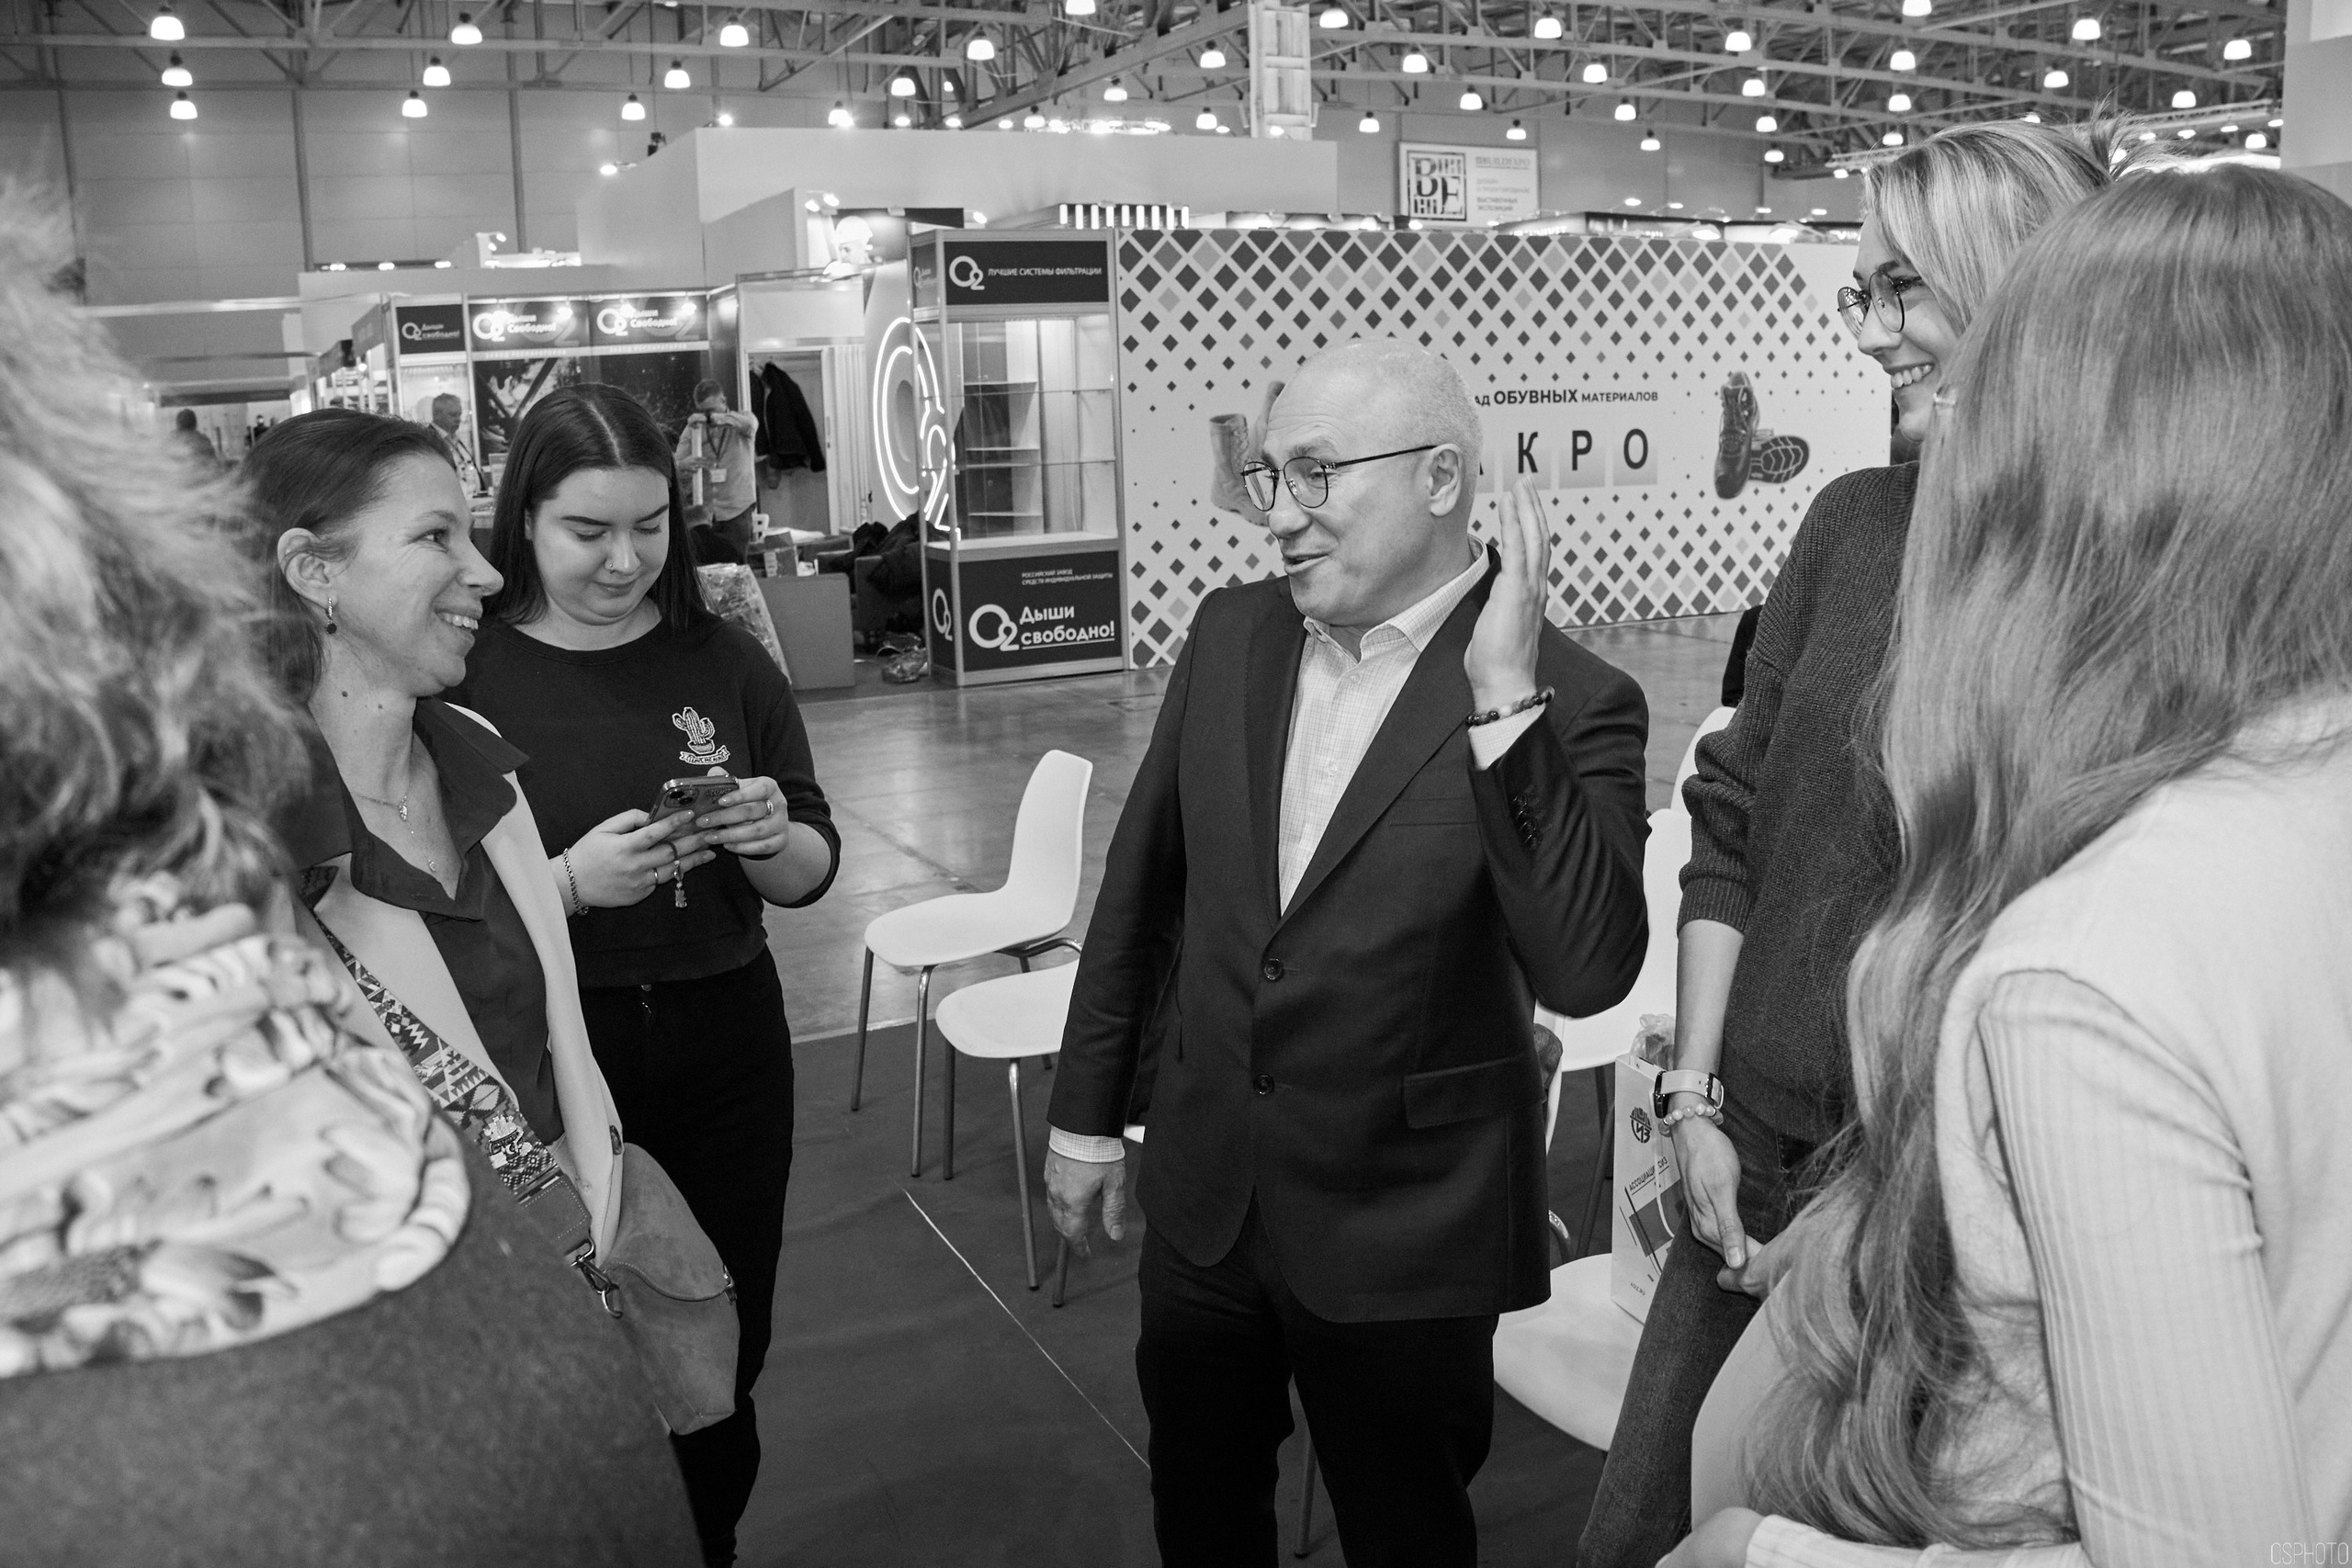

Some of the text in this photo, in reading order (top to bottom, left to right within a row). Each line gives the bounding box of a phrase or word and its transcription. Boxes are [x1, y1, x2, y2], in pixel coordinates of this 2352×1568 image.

[1493, 389, 1578, 405] ОБУВНЫХ
[1581, 391, 1658, 402] МАТЕРИАЛОВ
[1019, 605, 1075, 625] Дыши
[1021, 620, 1115, 646] свободно!
[1657, 1156, 1668, 1168] СИЗ
